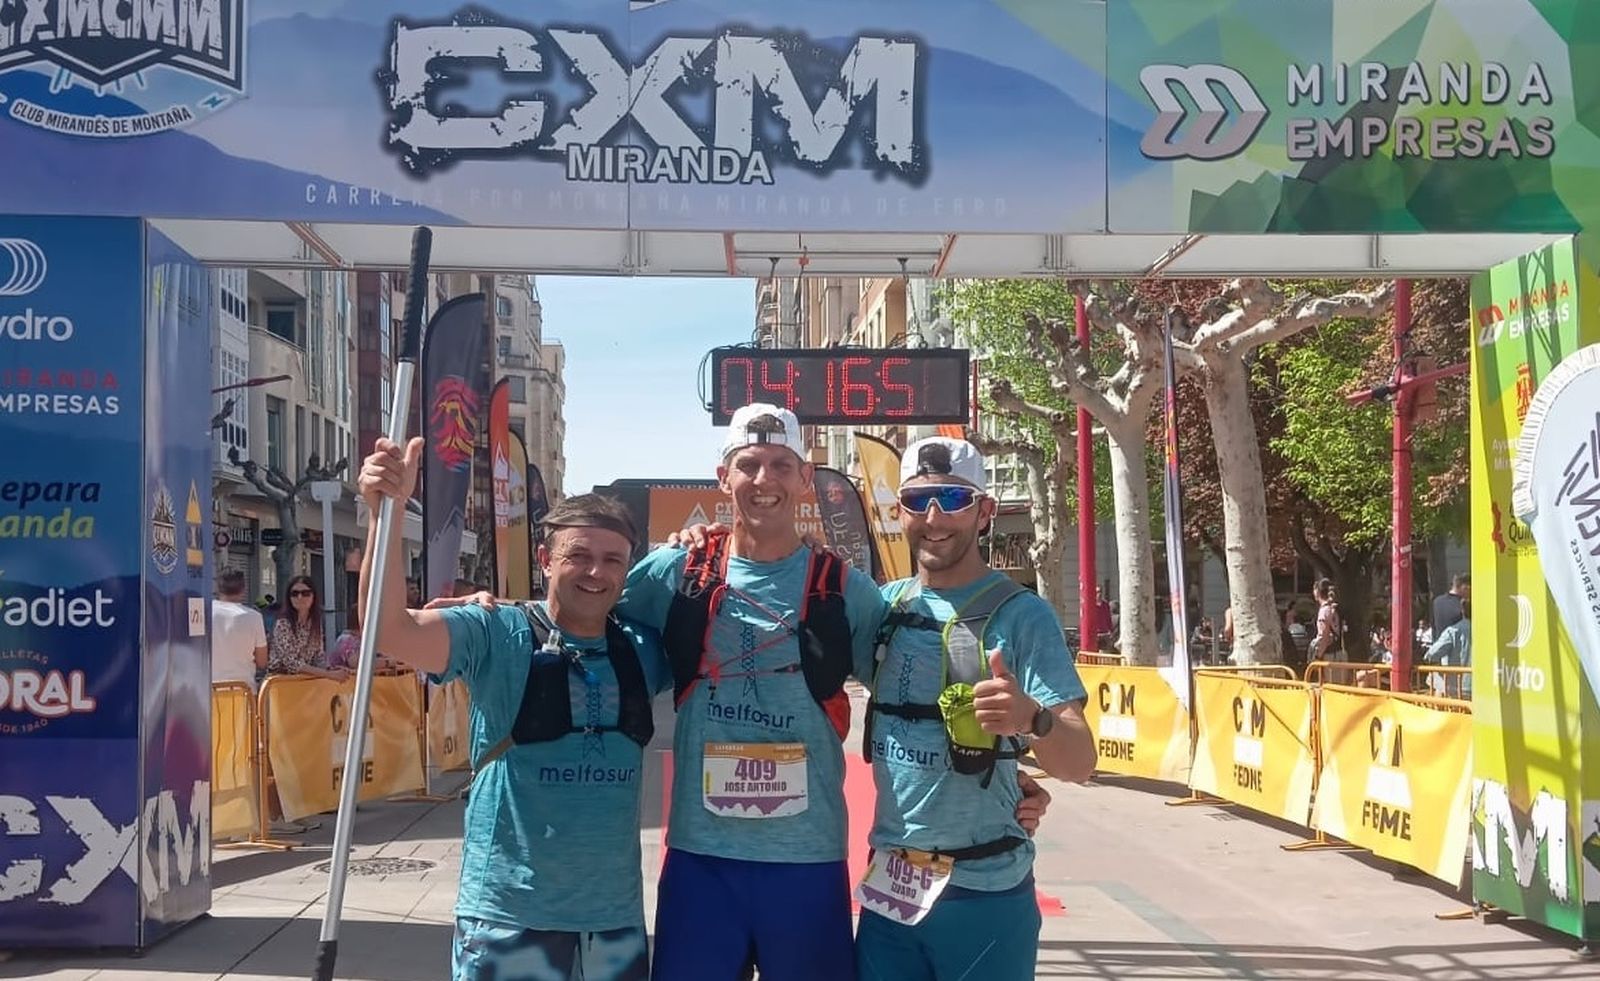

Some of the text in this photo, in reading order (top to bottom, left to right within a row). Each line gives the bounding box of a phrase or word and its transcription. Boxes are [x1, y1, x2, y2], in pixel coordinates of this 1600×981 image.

[388, 22, 918, 170] CXM
[1287, 62, 1553, 104] MIRANDA
[13, 102, 192, 133] CLUB MIRANDÉS DE MONTAÑA
[1287, 118, 1556, 158] EMPRESAS
[567, 145, 774, 184] MIRANDA
[1492, 657, 1545, 692] Hydro
[708, 702, 795, 729] melfosur
[539, 764, 635, 782] melfosur
[724, 782, 787, 792] JOSE ANTONIO
[734, 758, 777, 781] 409
[886, 853, 933, 890] 409-G
